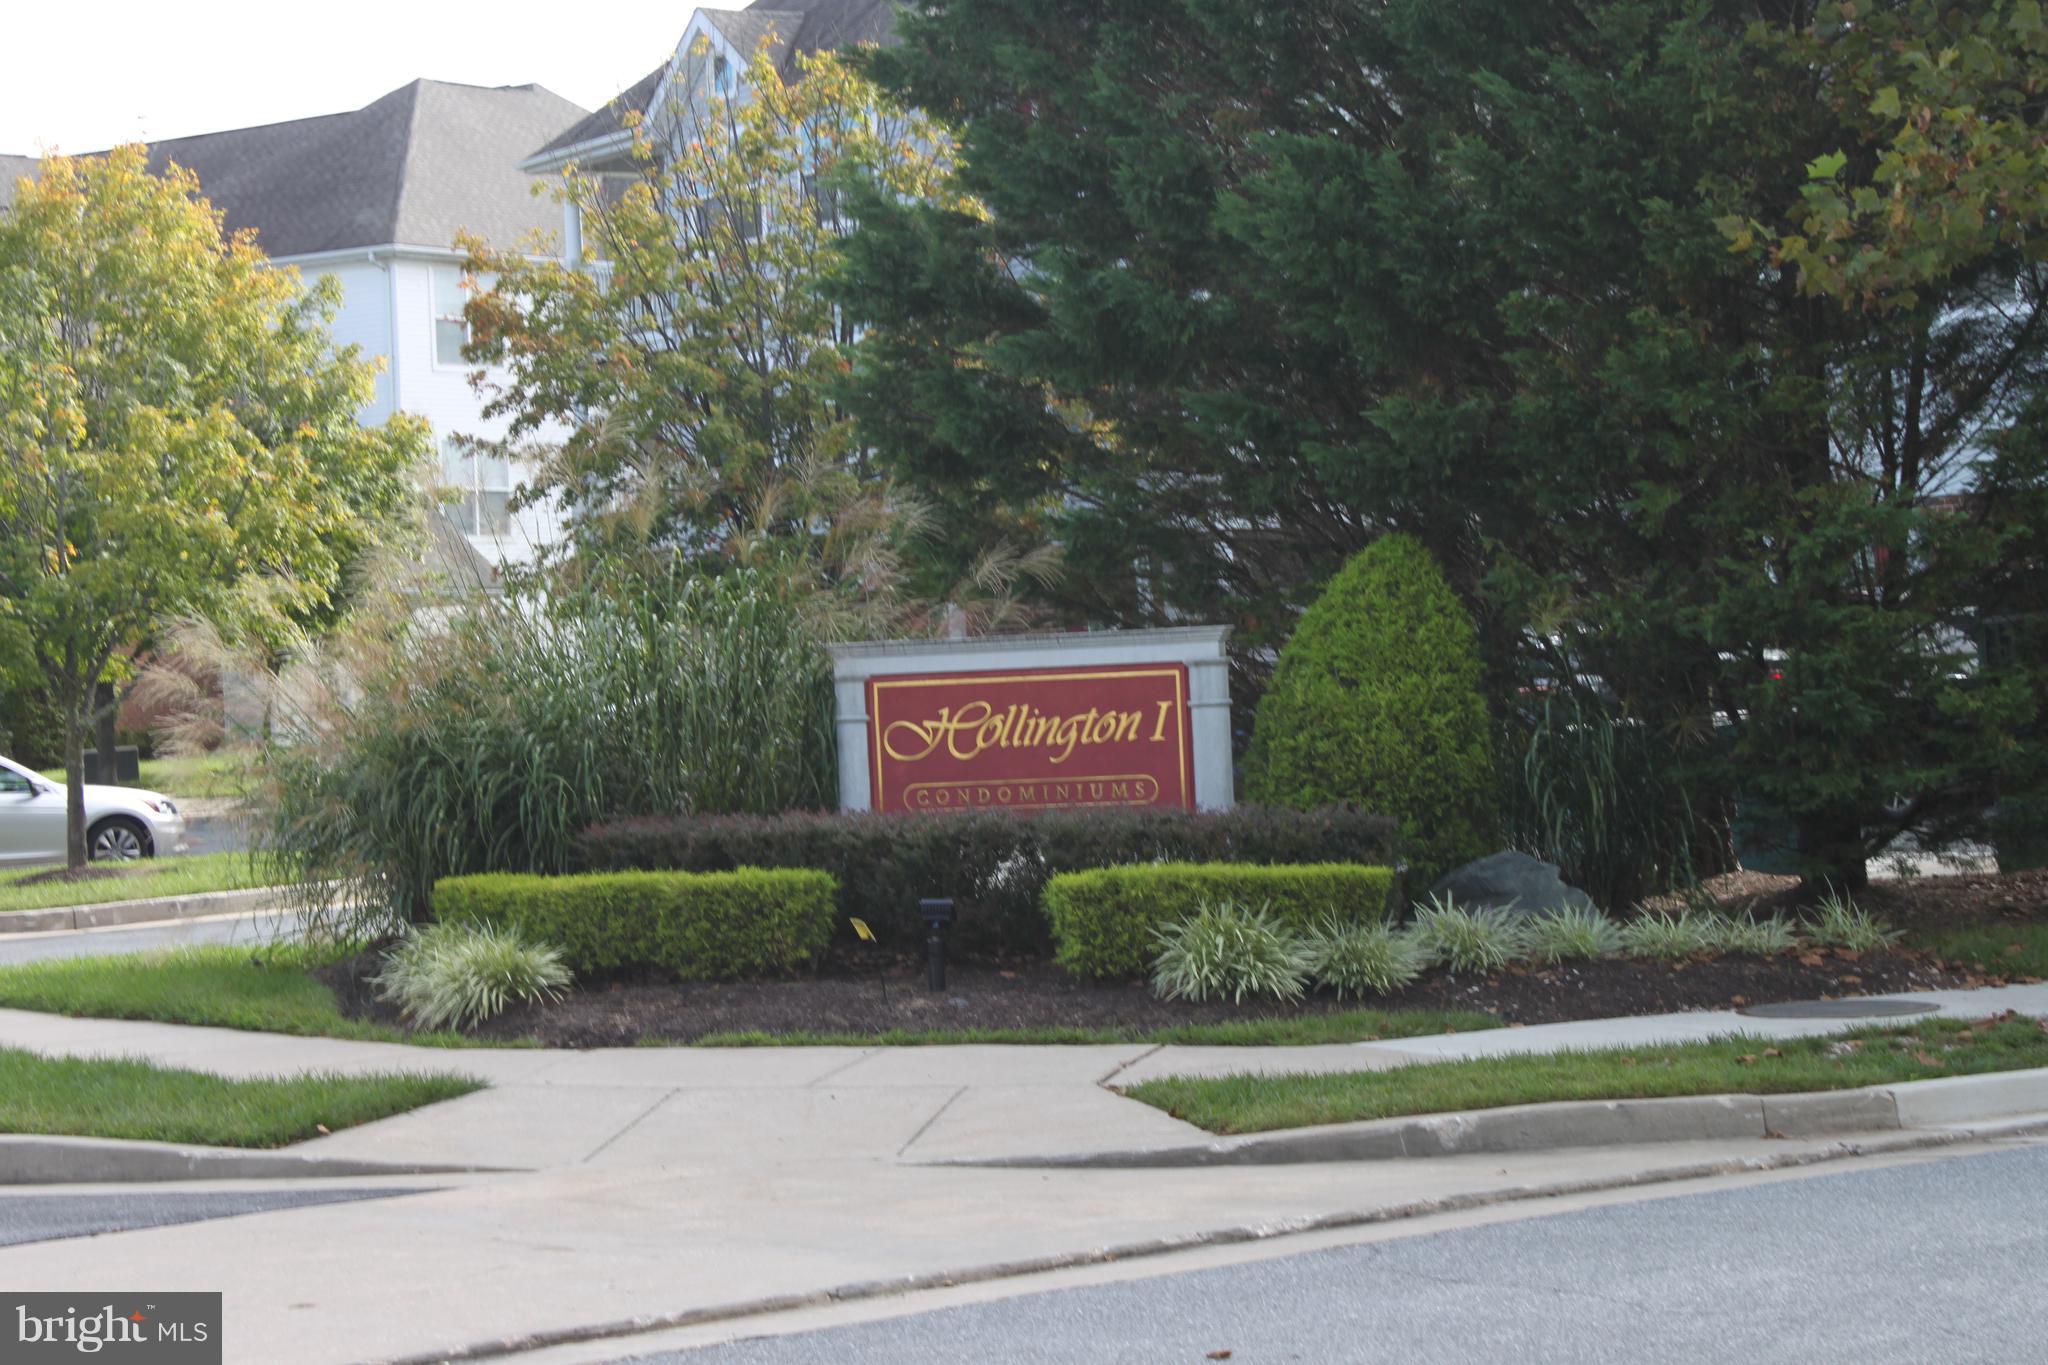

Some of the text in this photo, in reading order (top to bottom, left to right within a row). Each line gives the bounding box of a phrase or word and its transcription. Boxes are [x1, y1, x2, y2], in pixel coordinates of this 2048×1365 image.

[884, 699, 1173, 763] Hollington I
[916, 781, 1146, 806] CONDOMINIUMS
